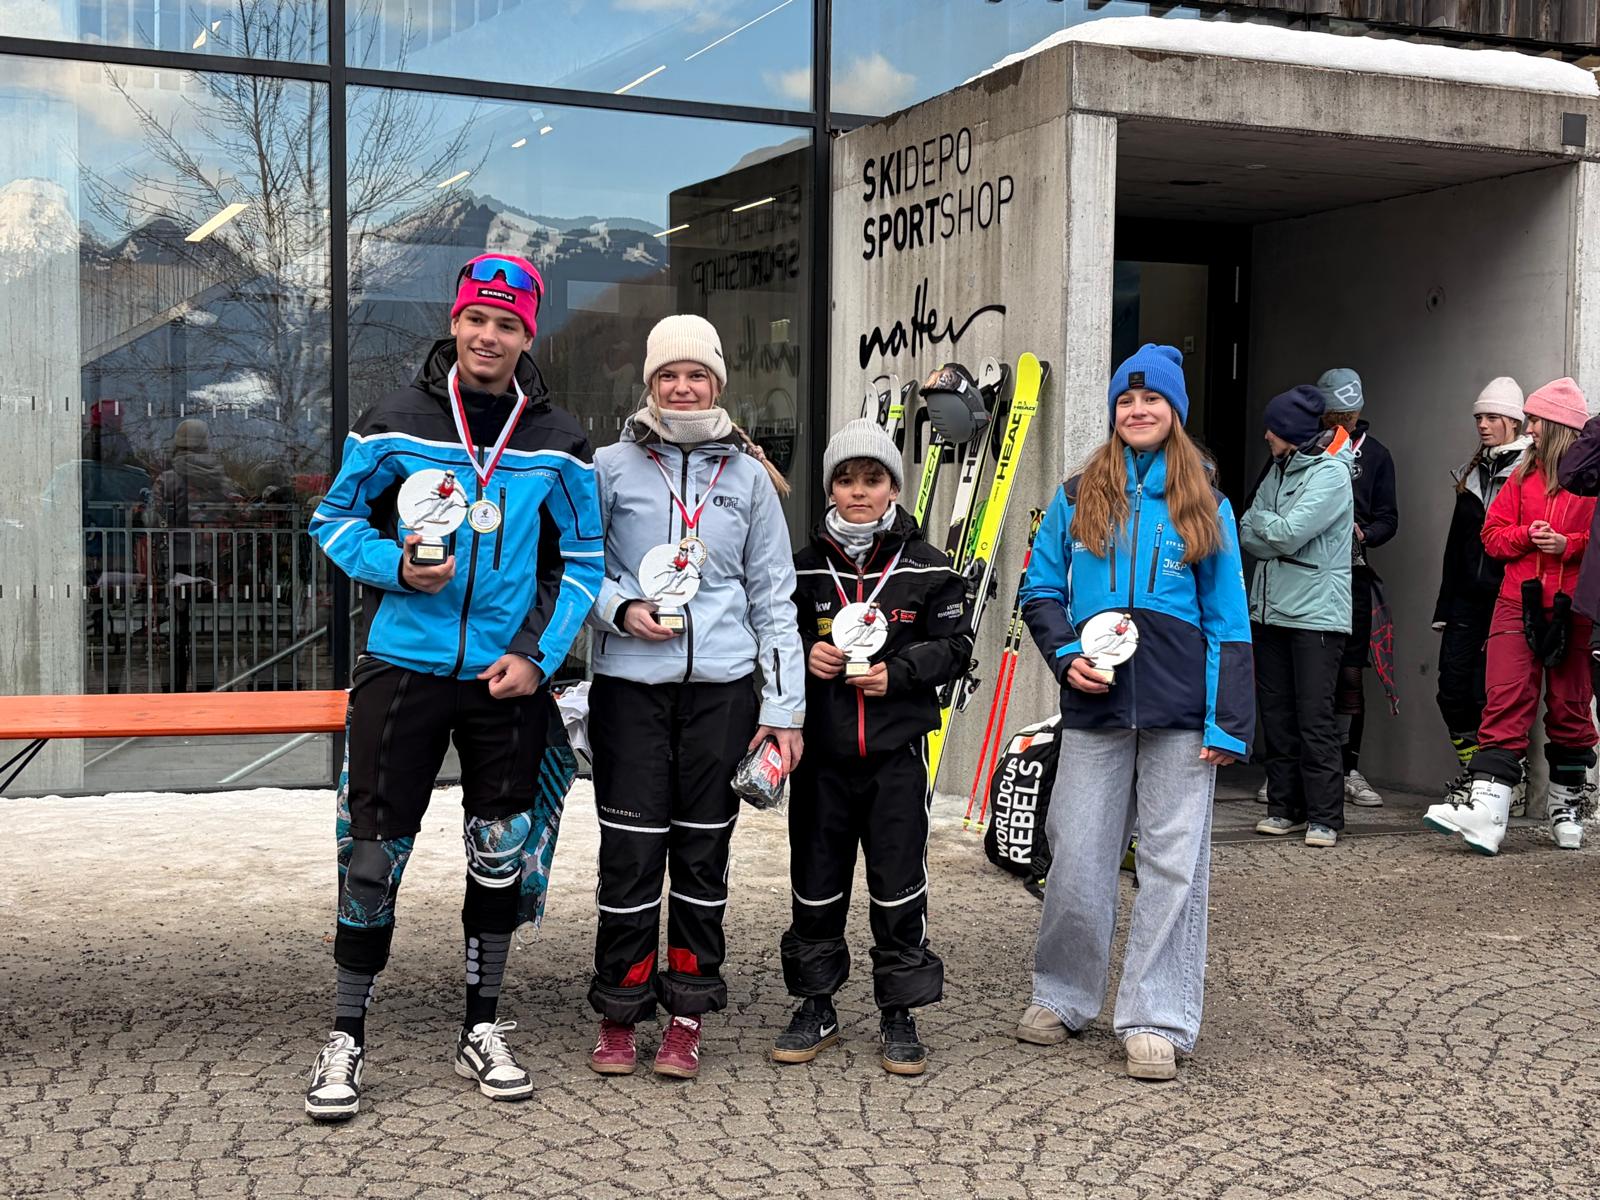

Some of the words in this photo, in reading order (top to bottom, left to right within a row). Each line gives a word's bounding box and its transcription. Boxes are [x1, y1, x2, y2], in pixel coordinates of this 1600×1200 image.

[862, 127, 972, 202] SKIDEPO
[862, 174, 1015, 261] SPORTSHOP
[995, 757, 1018, 858] WORLDCUP
[1009, 759, 1044, 864] REBELS
